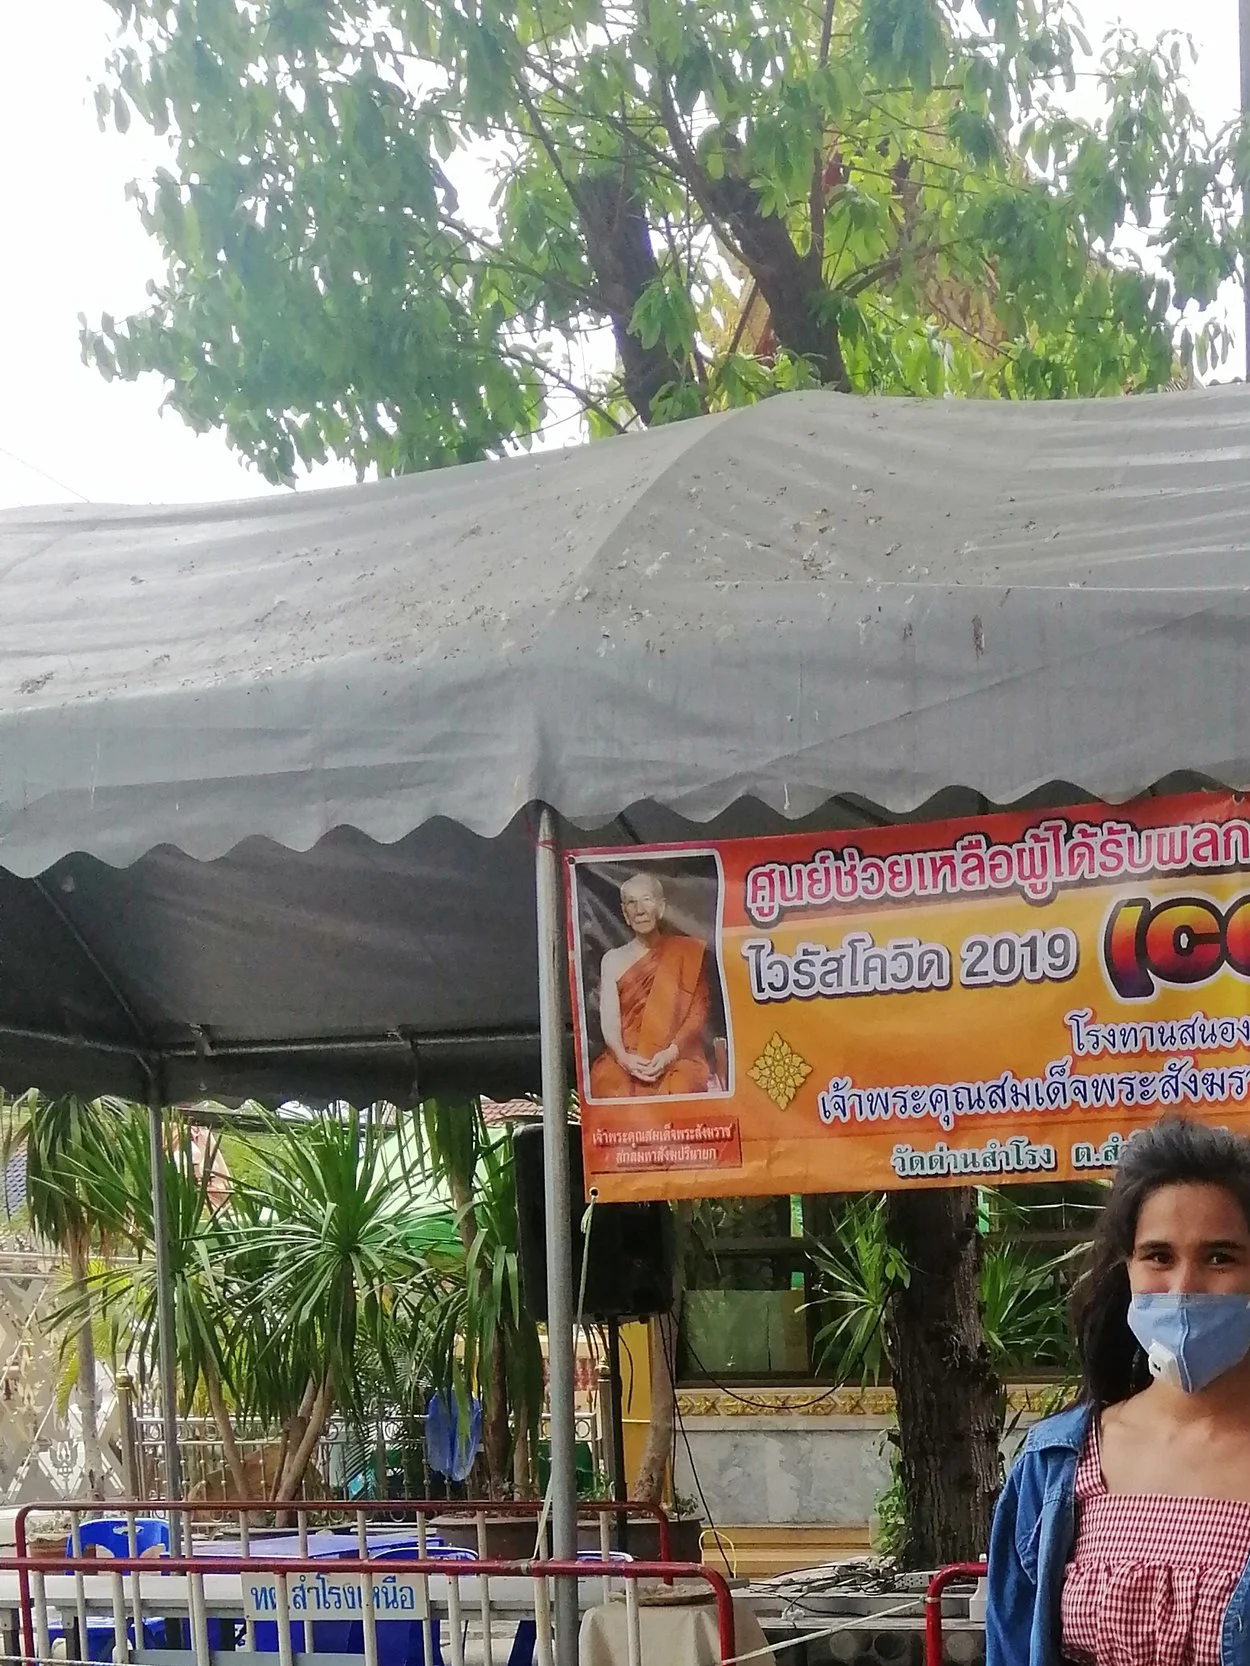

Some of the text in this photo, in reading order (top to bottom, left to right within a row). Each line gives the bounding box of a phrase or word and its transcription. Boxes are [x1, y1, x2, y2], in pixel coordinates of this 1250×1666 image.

[746, 936, 951, 995] ไวรัสโควิด
[963, 932, 1078, 980] 2019
[893, 1138, 1056, 1178] วัดด่านสำโรง
